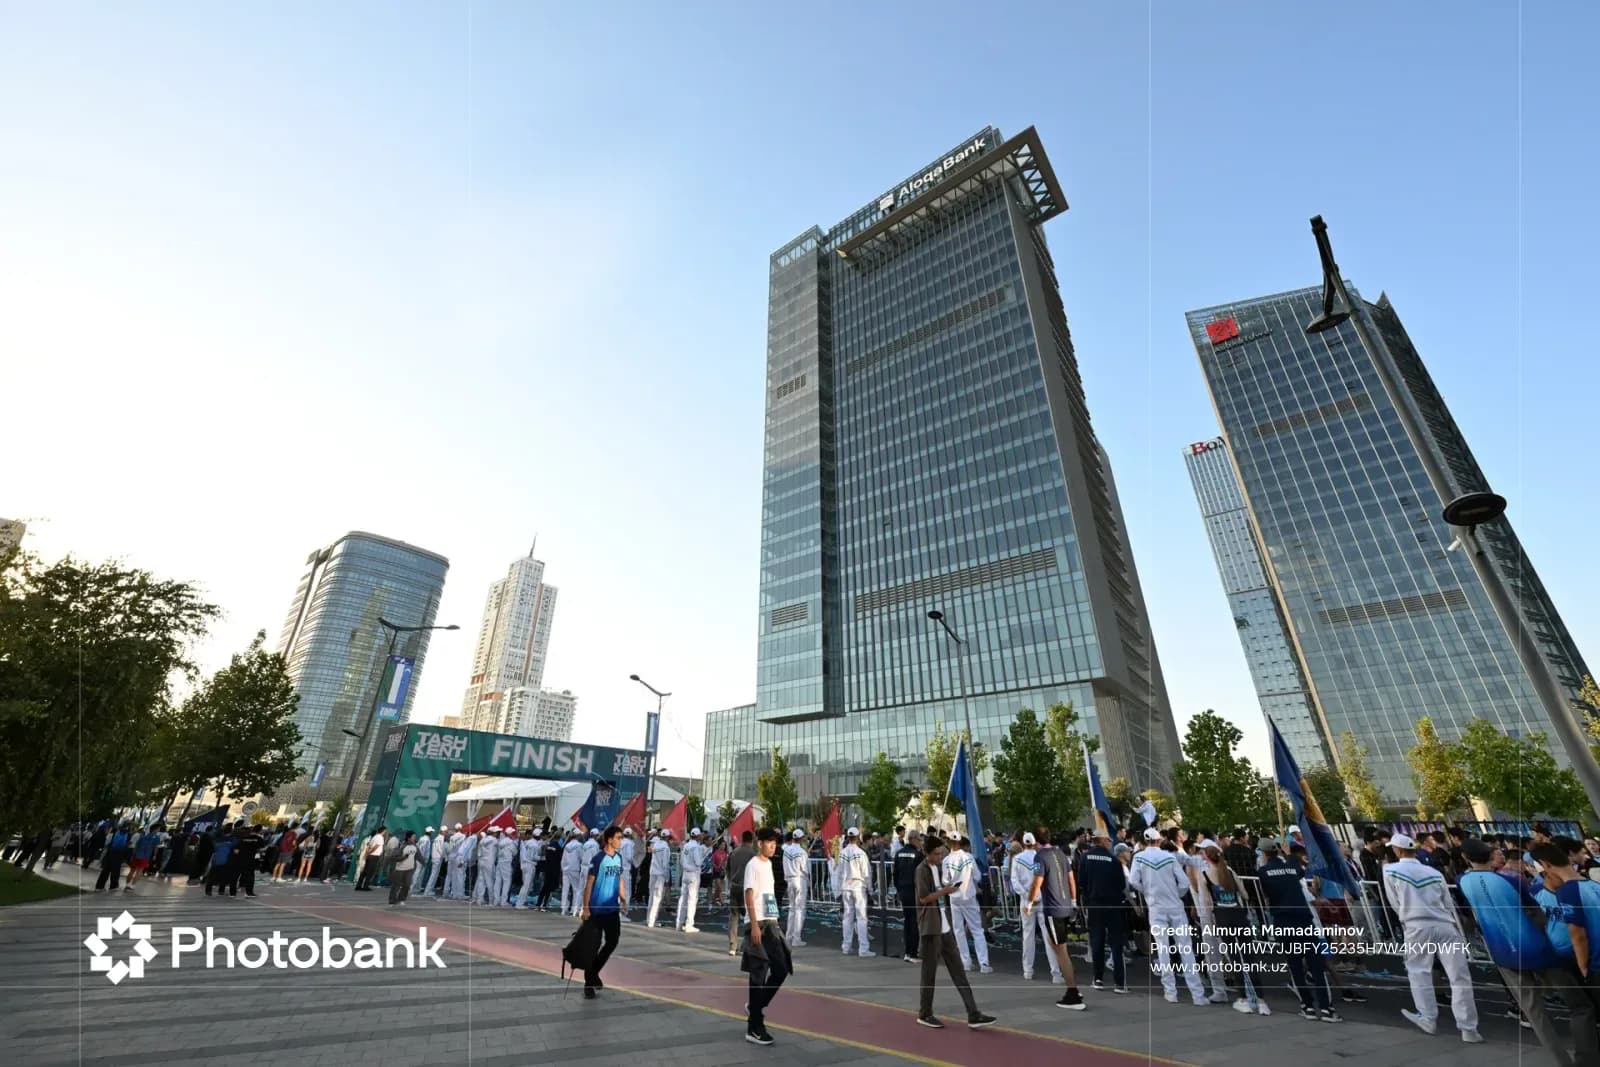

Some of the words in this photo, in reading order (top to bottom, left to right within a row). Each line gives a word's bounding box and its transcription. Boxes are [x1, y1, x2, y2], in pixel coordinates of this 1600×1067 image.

[898, 138, 986, 200] AloqaBank
[412, 742, 464, 758] KENT
[417, 731, 468, 751] TASH
[490, 739, 594, 774] FINISH
[615, 753, 648, 768] TASH
[612, 761, 644, 775] KENT
[393, 779, 441, 817] 35
